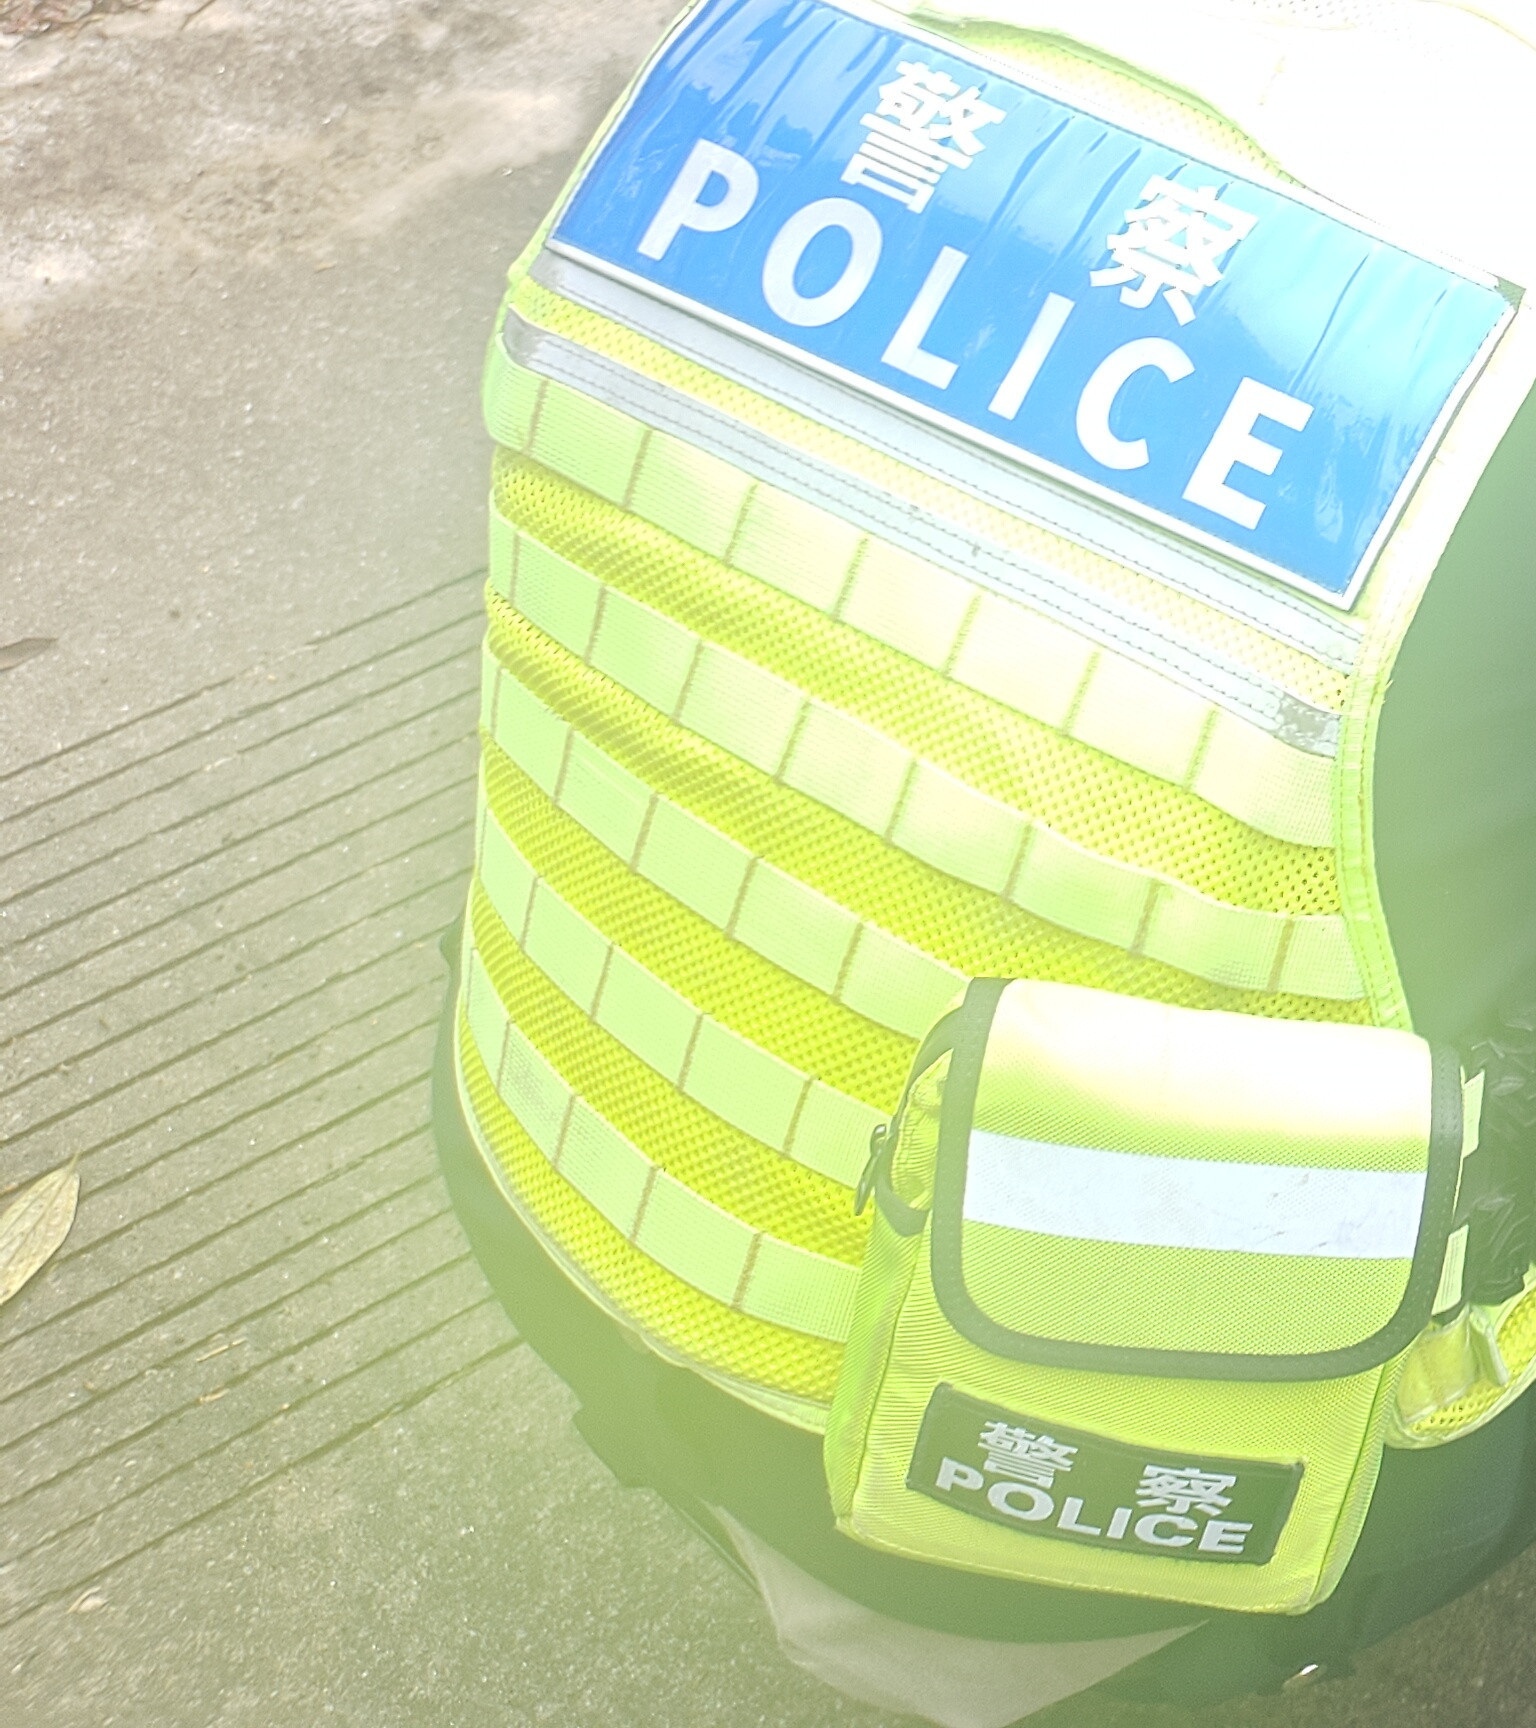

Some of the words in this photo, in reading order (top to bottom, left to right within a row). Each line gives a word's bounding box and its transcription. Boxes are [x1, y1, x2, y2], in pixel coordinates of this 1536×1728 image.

[842, 61, 1257, 325] 警察
[637, 138, 1313, 529] POLICE
[935, 1457, 1253, 1553] POLICE
[977, 1421, 1236, 1516] 警察
